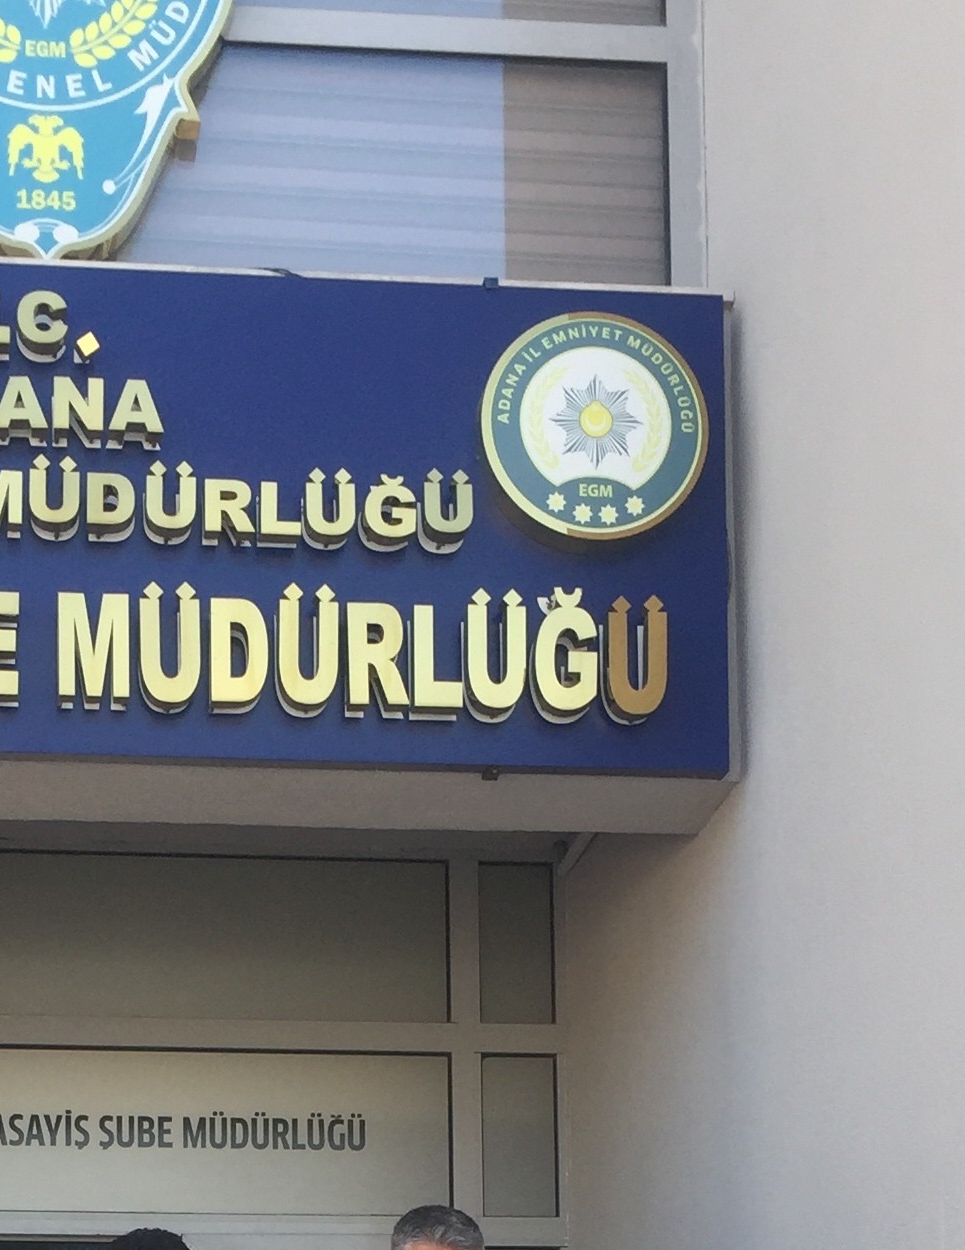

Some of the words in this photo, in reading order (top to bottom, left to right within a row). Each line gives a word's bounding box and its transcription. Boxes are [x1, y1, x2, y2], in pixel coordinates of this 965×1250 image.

[25, 39, 66, 58] EGM
[16, 188, 76, 212] 1845
[497, 363, 526, 424] ADANA
[521, 346, 542, 363] İL
[541, 324, 624, 350] EMNİYET
[579, 483, 613, 498] EGM
[58, 580, 668, 719] MÜDÜRLÜĞÜ
[99, 1113, 173, 1151] ŞUBE
[182, 1111, 366, 1152] MÜDÜRLÜĞÜ
